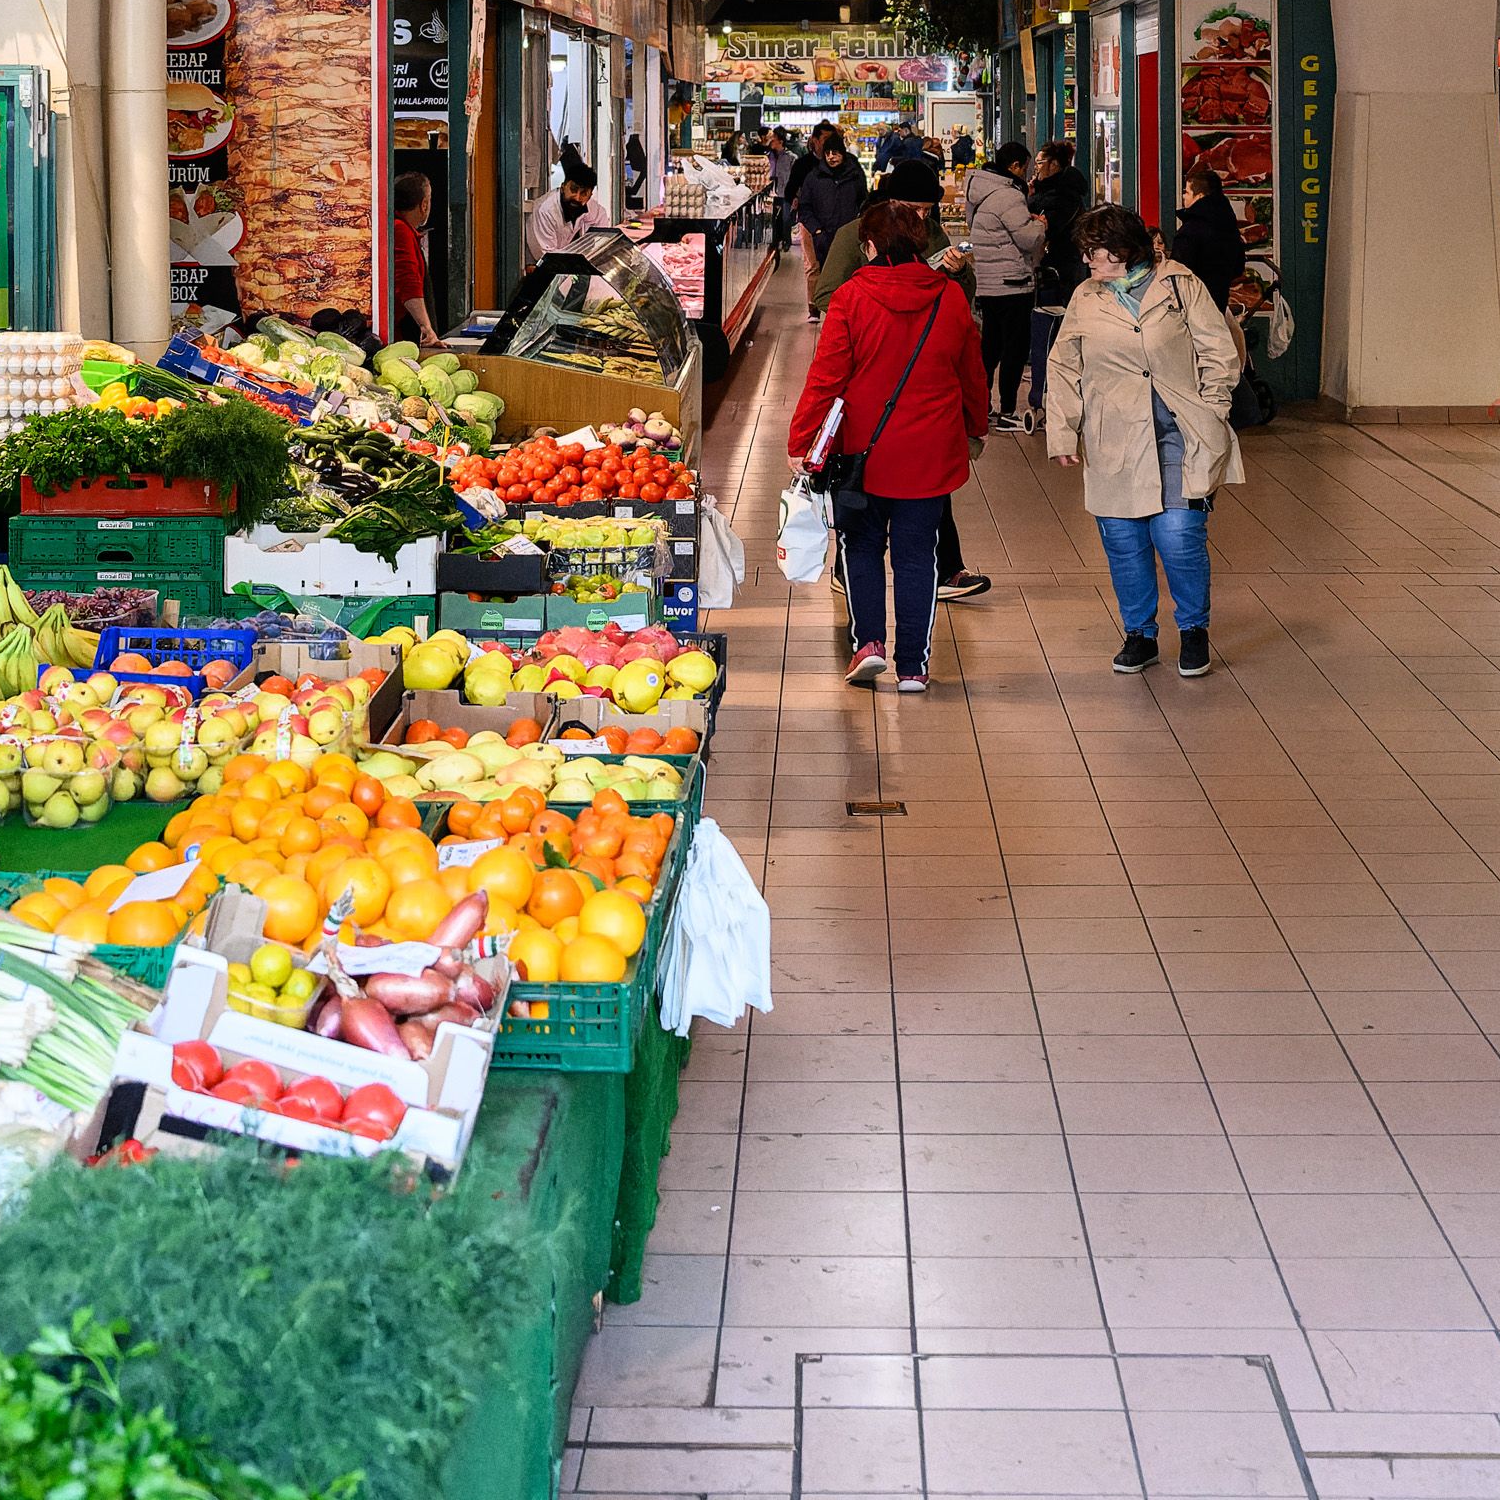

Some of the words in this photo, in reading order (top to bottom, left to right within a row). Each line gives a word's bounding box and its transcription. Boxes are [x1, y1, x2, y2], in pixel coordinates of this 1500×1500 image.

[727, 31, 821, 60] Simar
[831, 30, 940, 59] Feinko
[166, 52, 208, 68] EBAP
[167, 69, 222, 85] NDWICH
[1299, 54, 1322, 244] GEFLÜGEL
[168, 163, 210, 183] ÜRÜM
[170, 268, 209, 284] EBAP
[171, 286, 198, 301] BOX
[663, 604, 694, 619] lavor
